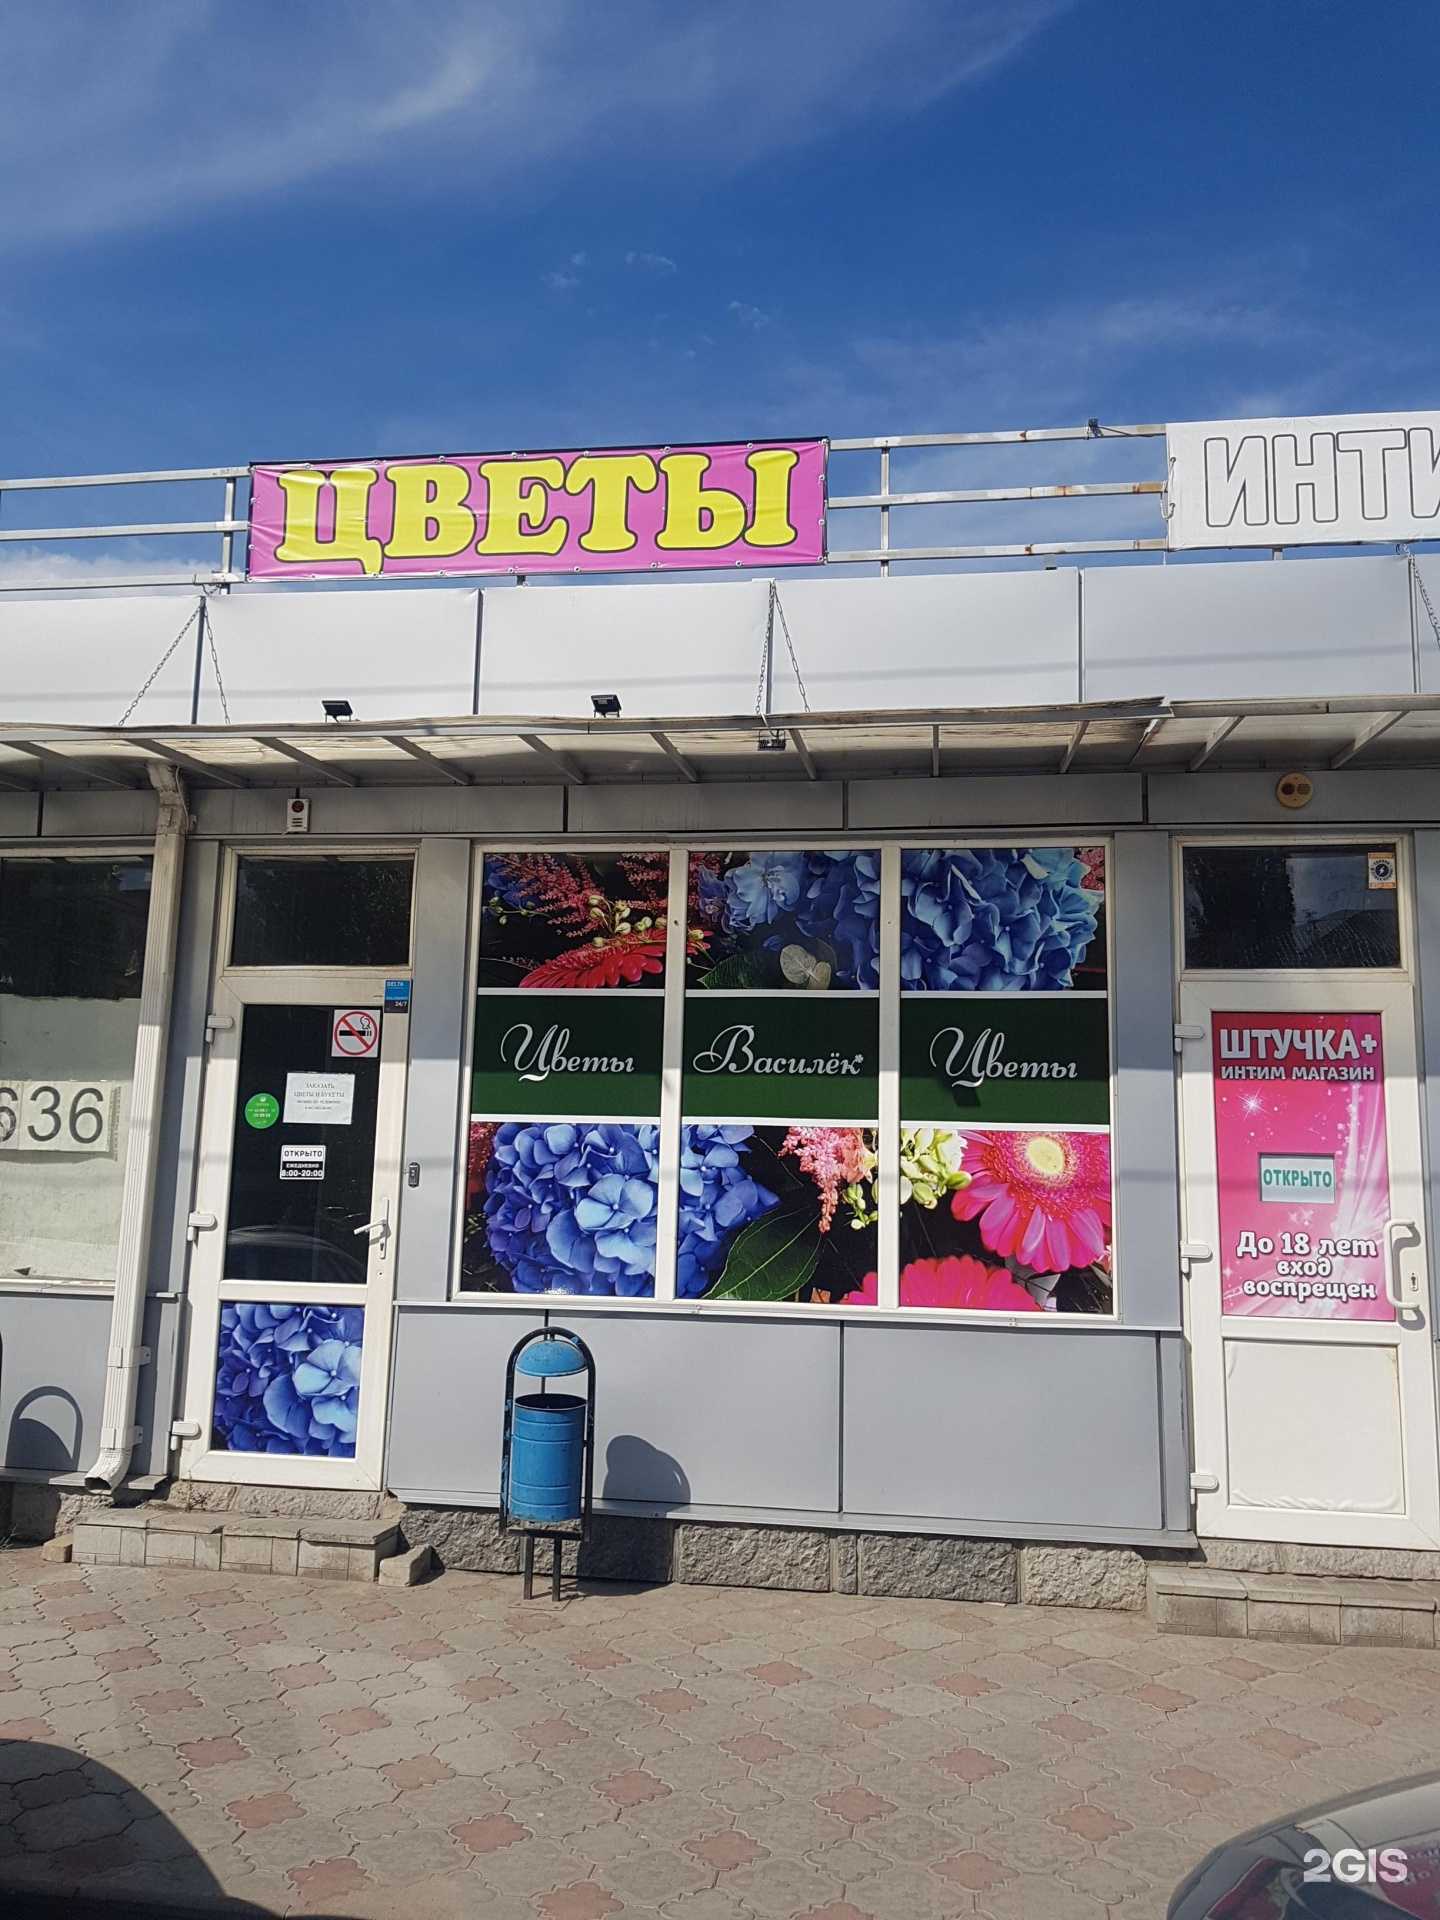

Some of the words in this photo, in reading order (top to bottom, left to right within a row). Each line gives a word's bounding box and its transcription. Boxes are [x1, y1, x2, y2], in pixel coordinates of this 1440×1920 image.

[273, 449, 799, 575] ЦВЕТЫ
[500, 1023, 635, 1082] Цветы
[1219, 1028, 1378, 1061] ШТУЧКА+
[929, 1027, 1078, 1089] Цветы
[1221, 1066, 1286, 1080] ИНТИМ
[1292, 1067, 1375, 1081] МАГАЗИН
[1263, 1169, 1332, 1187] ОТКРЫТО
[1236, 1231, 1274, 1257] До
[1281, 1232, 1310, 1255] 18
[1318, 1238, 1378, 1256] лет
[1276, 1256, 1332, 1276] вход
[1243, 1280, 1377, 1302] воспрещен
